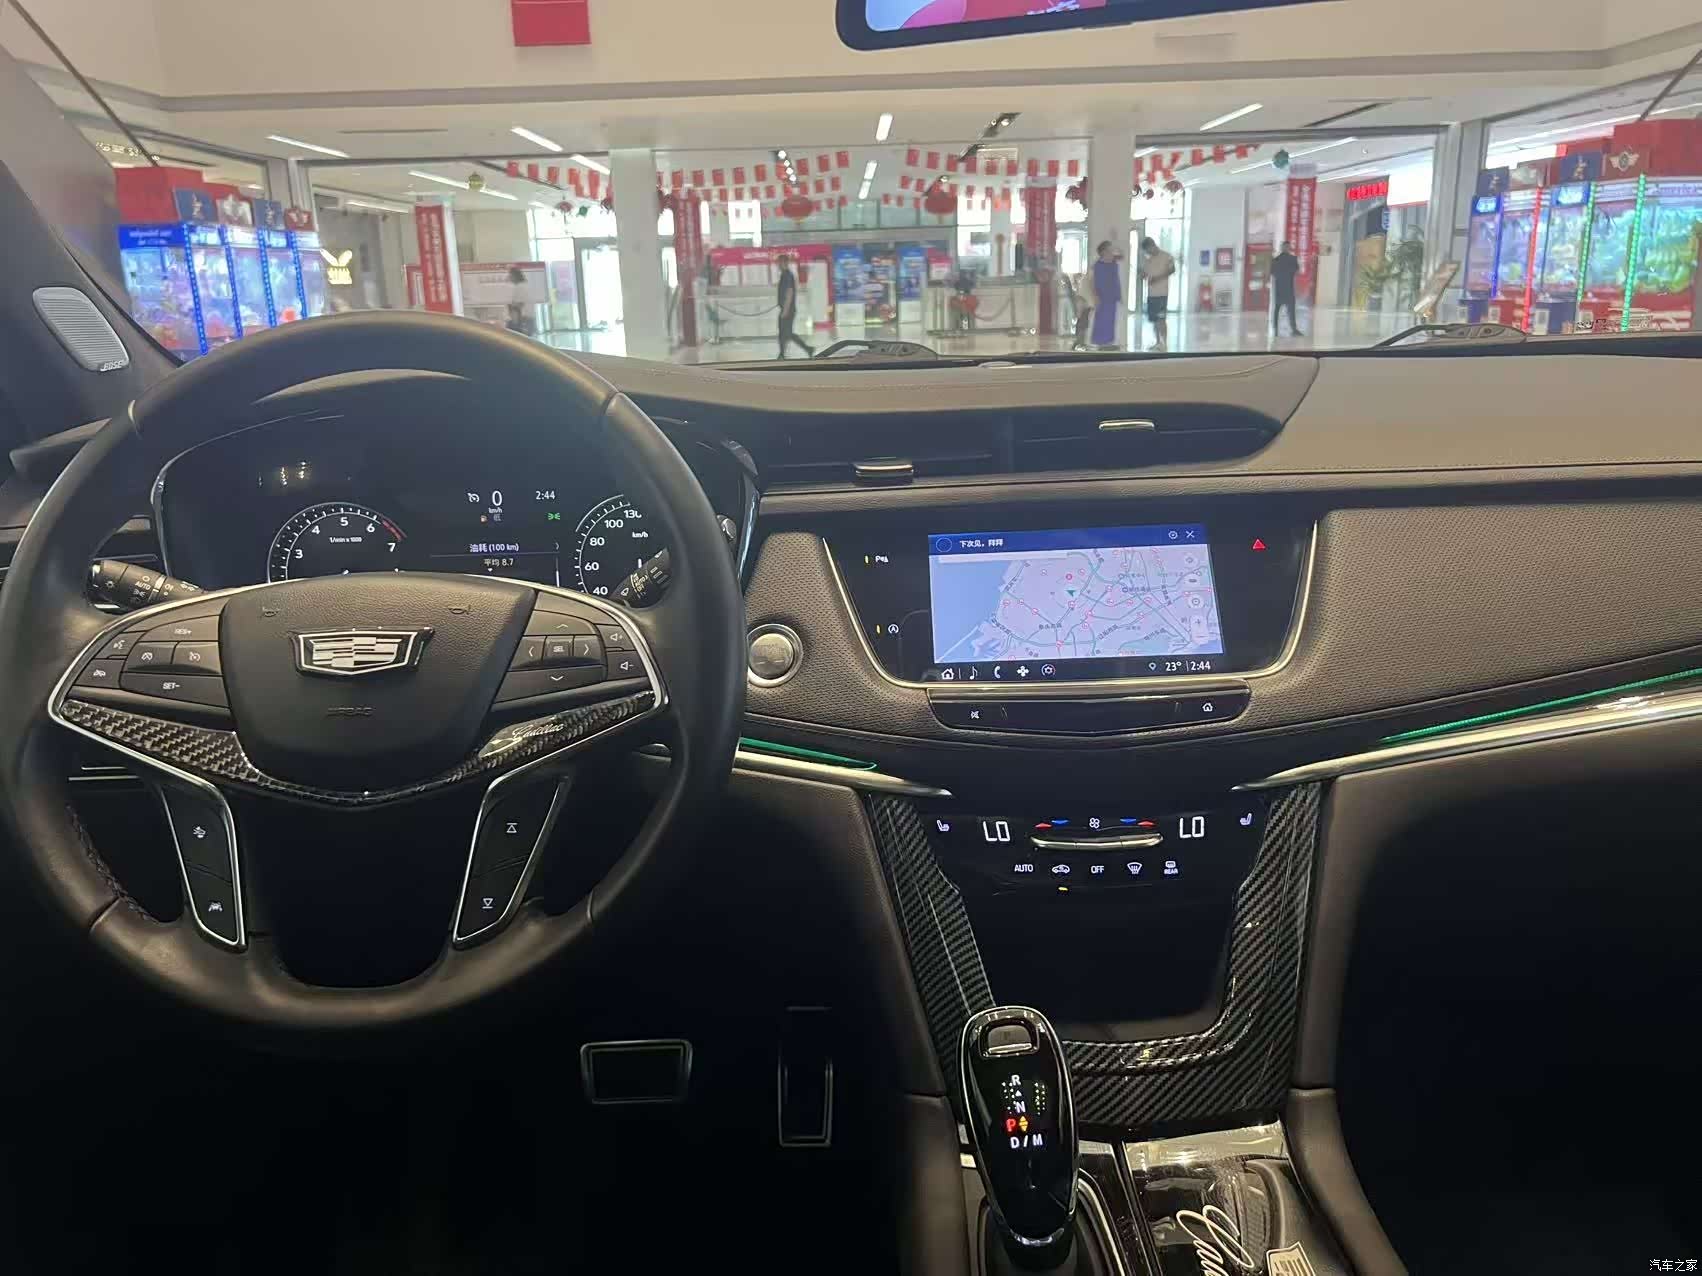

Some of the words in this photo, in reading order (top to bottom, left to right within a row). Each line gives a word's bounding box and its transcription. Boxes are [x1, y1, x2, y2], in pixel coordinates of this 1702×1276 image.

[491, 490, 503, 507] 0
[535, 490, 556, 500] 2:44
[340, 517, 349, 526] 5
[604, 519, 624, 529] 100
[311, 525, 320, 535] 4
[366, 523, 375, 533] 6
[589, 537, 605, 546] 80
[387, 543, 396, 552] 7
[469, 543, 488, 553] 油耗
[488, 543, 505, 553] (100
[506, 543, 520, 552] km)
[295, 549, 304, 559] 3
[501, 558, 514, 566] 8.7
[584, 561, 600, 571] 60
[135, 580, 152, 591] AUTO
[592, 586, 608, 596] 40
[1165, 661, 1182, 672] 23°
[1190, 661, 1211, 671] 2:44
[1014, 863, 1034, 874] AUTO
[1090, 864, 1105, 874] OFF
[1011, 1074, 1021, 1086] R
[1015, 1100, 1026, 1113] N
[1005, 1118, 1017, 1132] P
